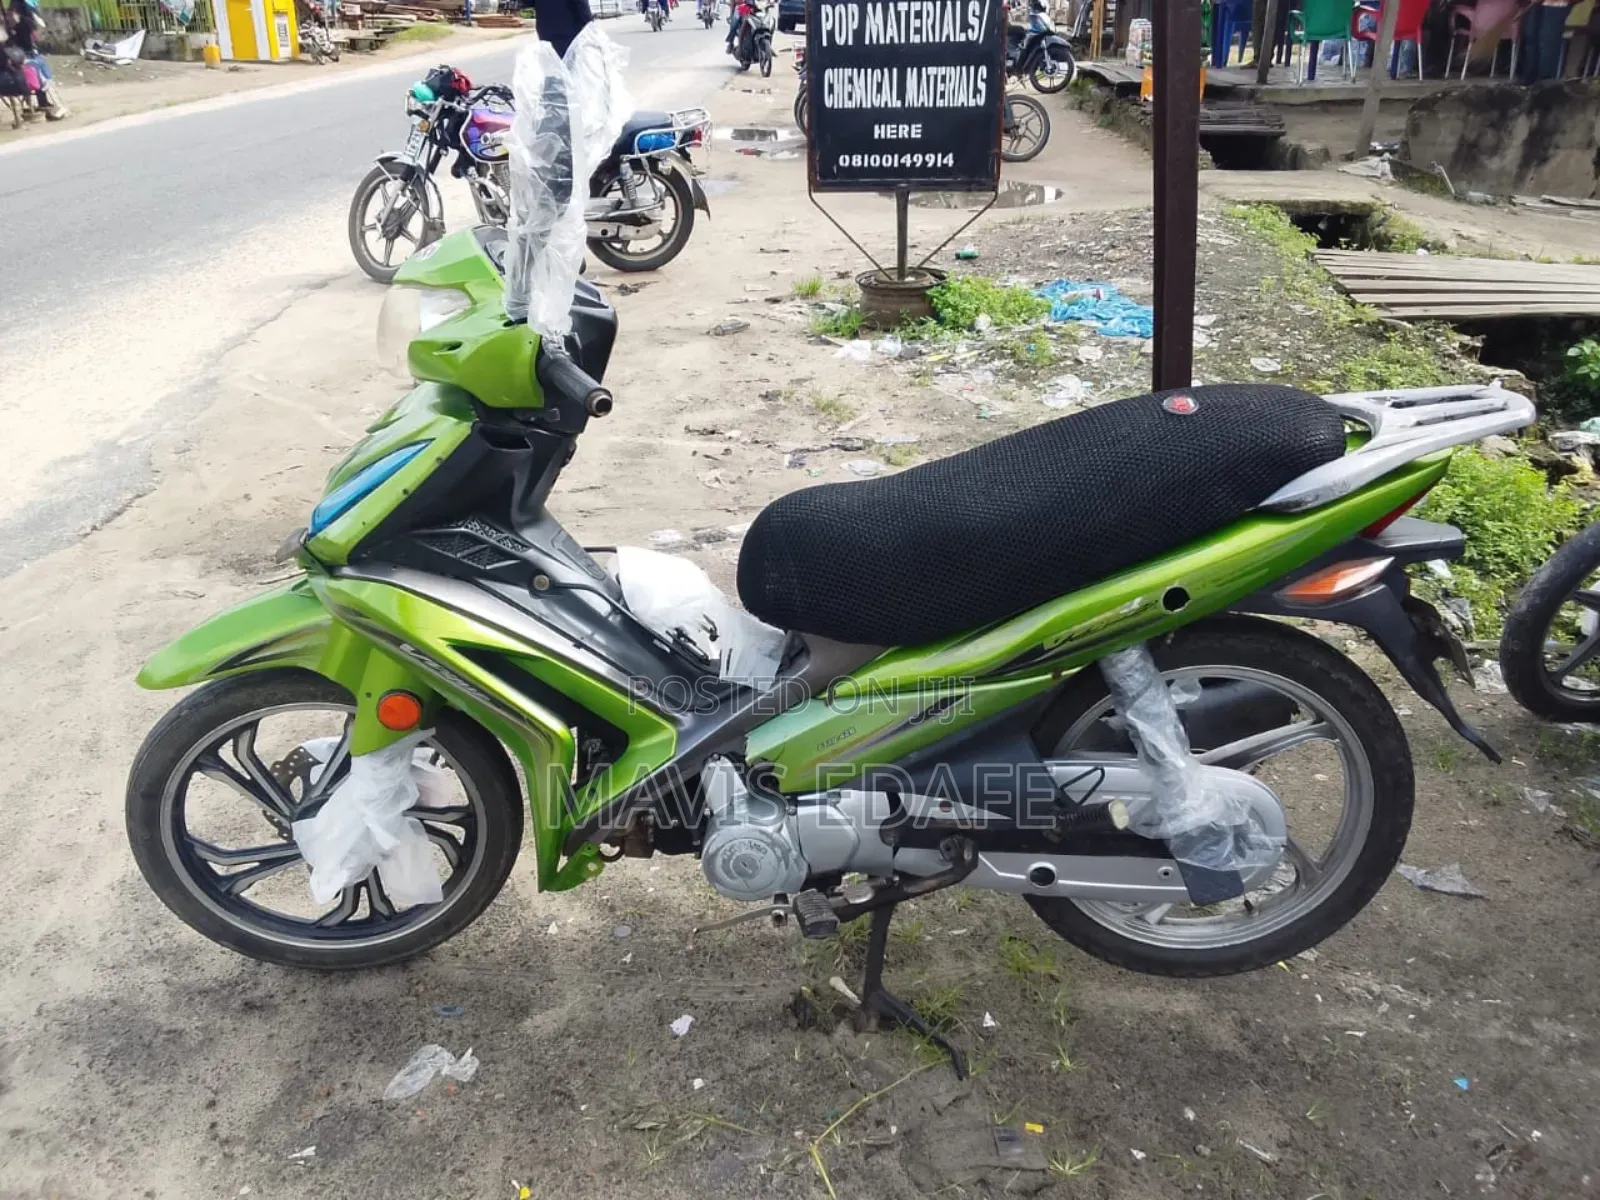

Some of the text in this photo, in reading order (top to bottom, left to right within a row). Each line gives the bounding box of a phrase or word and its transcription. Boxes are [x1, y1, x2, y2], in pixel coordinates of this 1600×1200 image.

[821, 0, 990, 47] POP MATERIALS/
[824, 65, 987, 109] CHEMICAL MATERIALS
[873, 124, 923, 140] HERE
[838, 152, 955, 168] 08100149914
